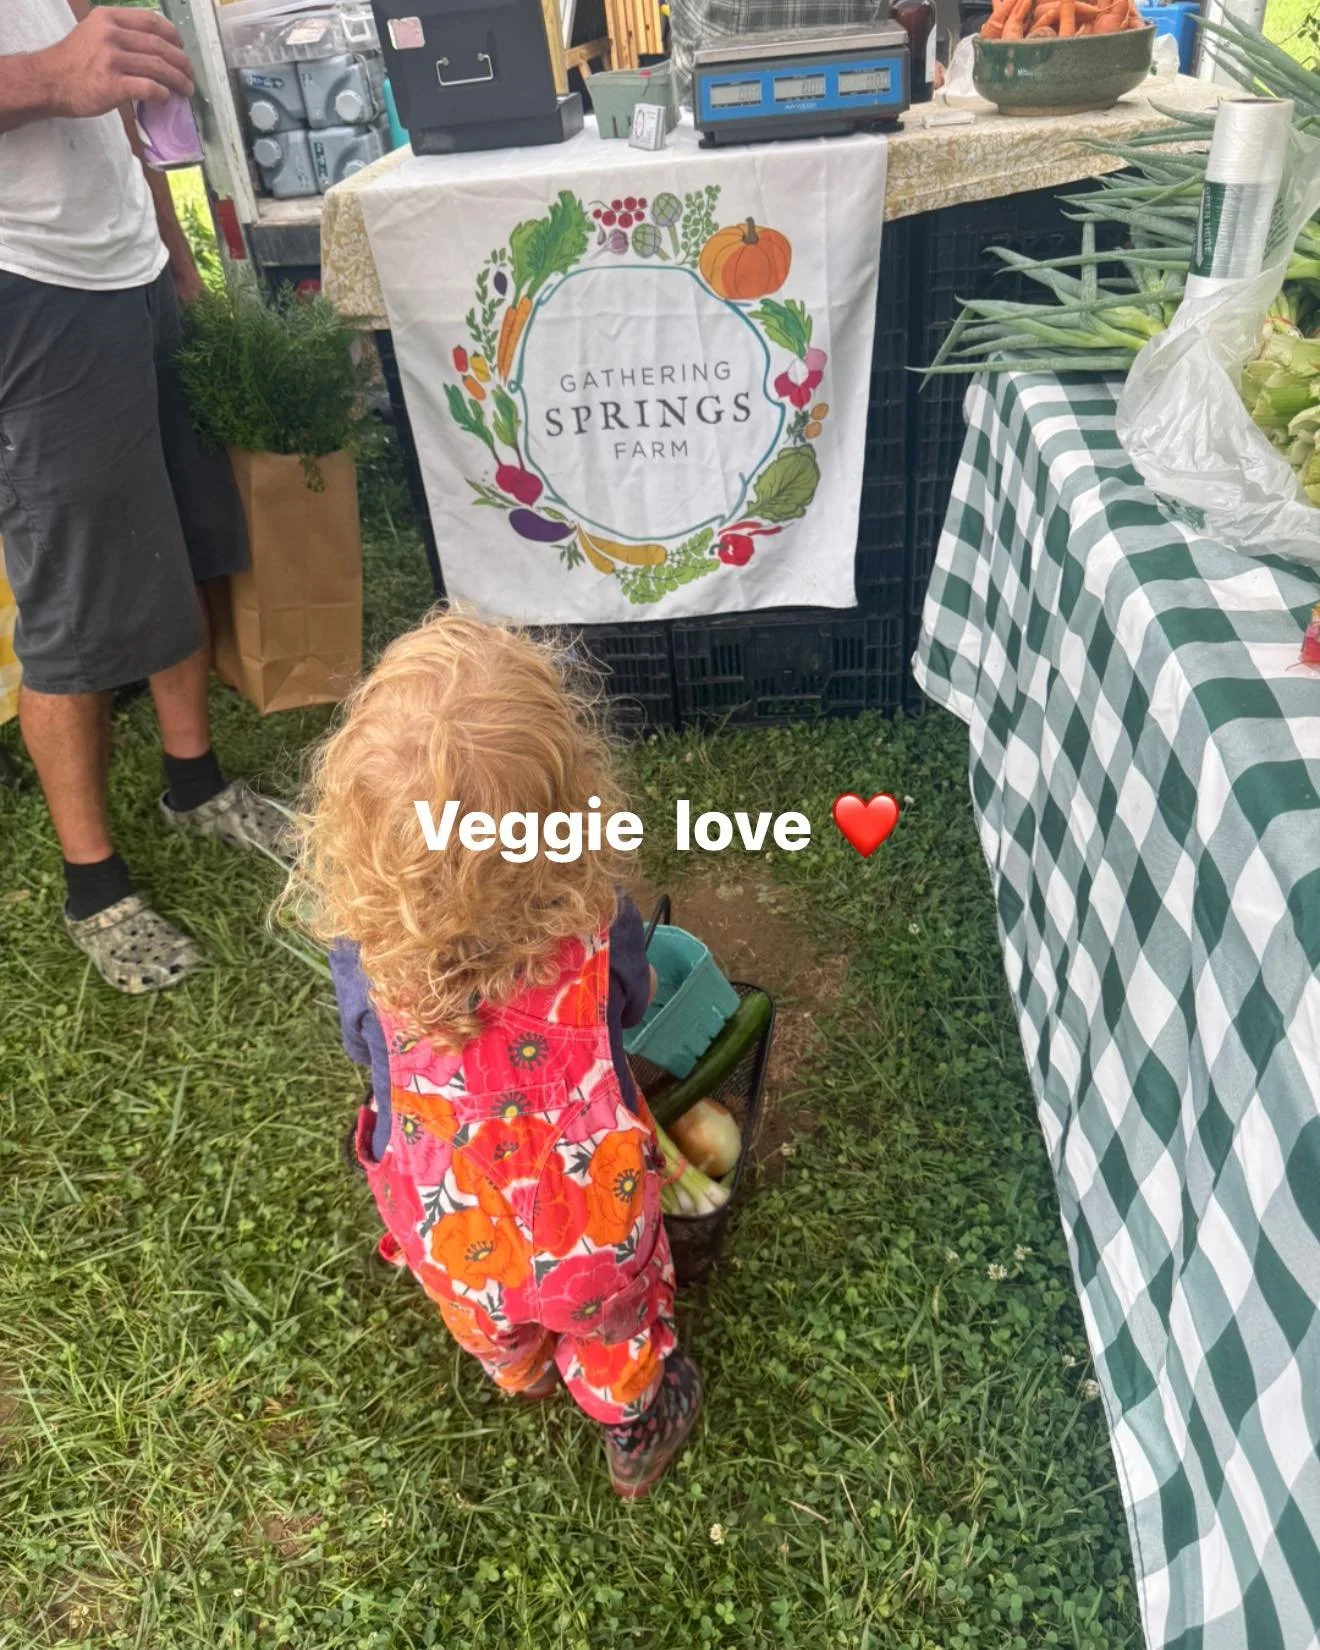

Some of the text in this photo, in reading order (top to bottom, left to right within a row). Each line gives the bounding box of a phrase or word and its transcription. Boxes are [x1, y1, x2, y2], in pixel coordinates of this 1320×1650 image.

[560, 361, 731, 393] GATHERING
[545, 392, 751, 437] SPRINGS
[614, 440, 689, 460] FARM
